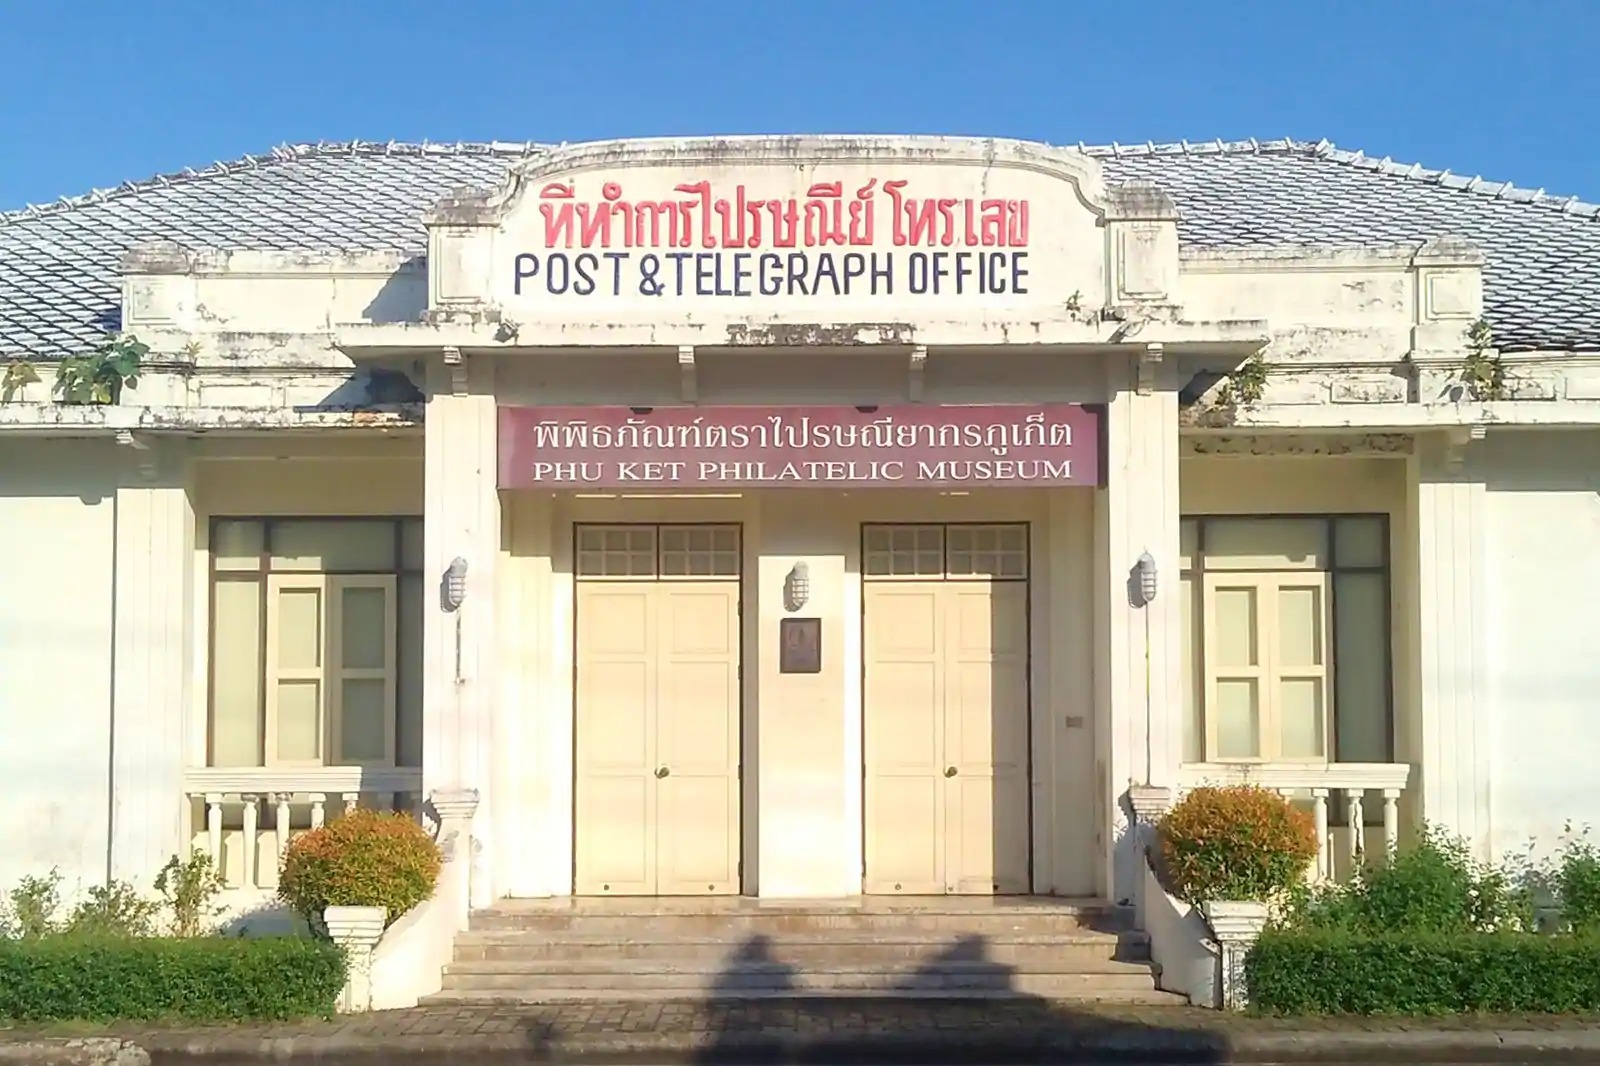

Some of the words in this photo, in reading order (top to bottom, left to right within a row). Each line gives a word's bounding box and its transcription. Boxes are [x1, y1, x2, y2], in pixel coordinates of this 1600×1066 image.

[883, 179, 1029, 247] โทรเลข
[514, 252, 630, 296] POST
[665, 252, 893, 296] TELEGRAPH
[909, 252, 1029, 295] OFFICE
[533, 412, 1073, 455] พิพิธภัณฑ์ตราไปรษณียากรภูเก็ต
[533, 461, 604, 482] PHU
[617, 461, 686, 481] KET
[698, 461, 904, 481] PHILATELIC
[917, 460, 1073, 480] MUSEUM
